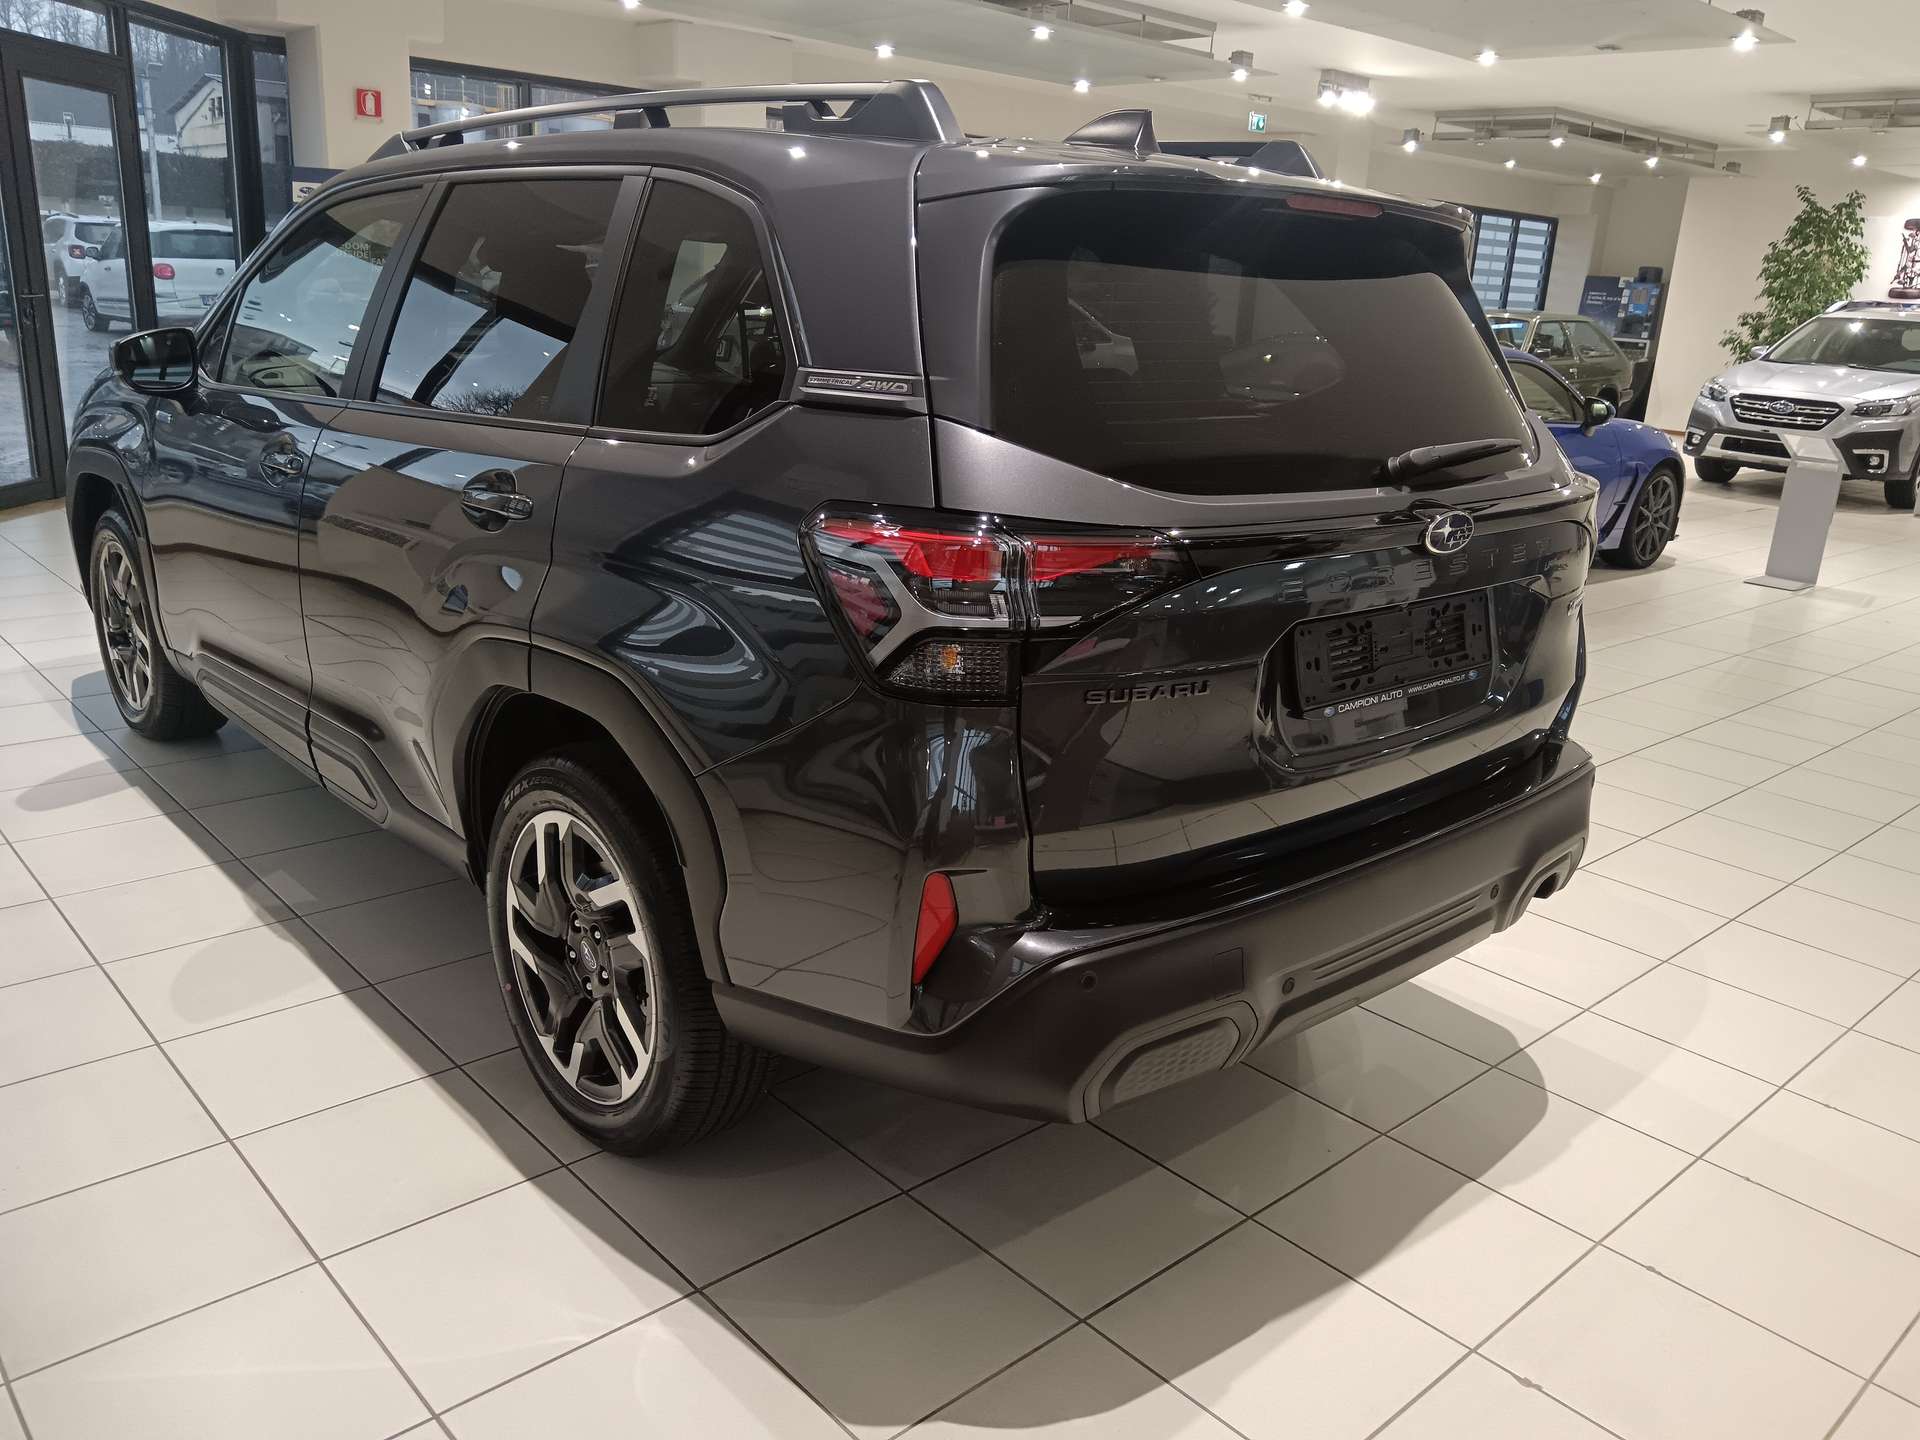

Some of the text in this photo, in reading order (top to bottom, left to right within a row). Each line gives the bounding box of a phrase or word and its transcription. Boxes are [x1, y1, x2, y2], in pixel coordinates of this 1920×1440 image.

[860, 379, 908, 393] AWD
[1084, 680, 1211, 705] SUBARU
[1337, 695, 1379, 712] CAMPIONI
[1380, 689, 1404, 703] AUTO
